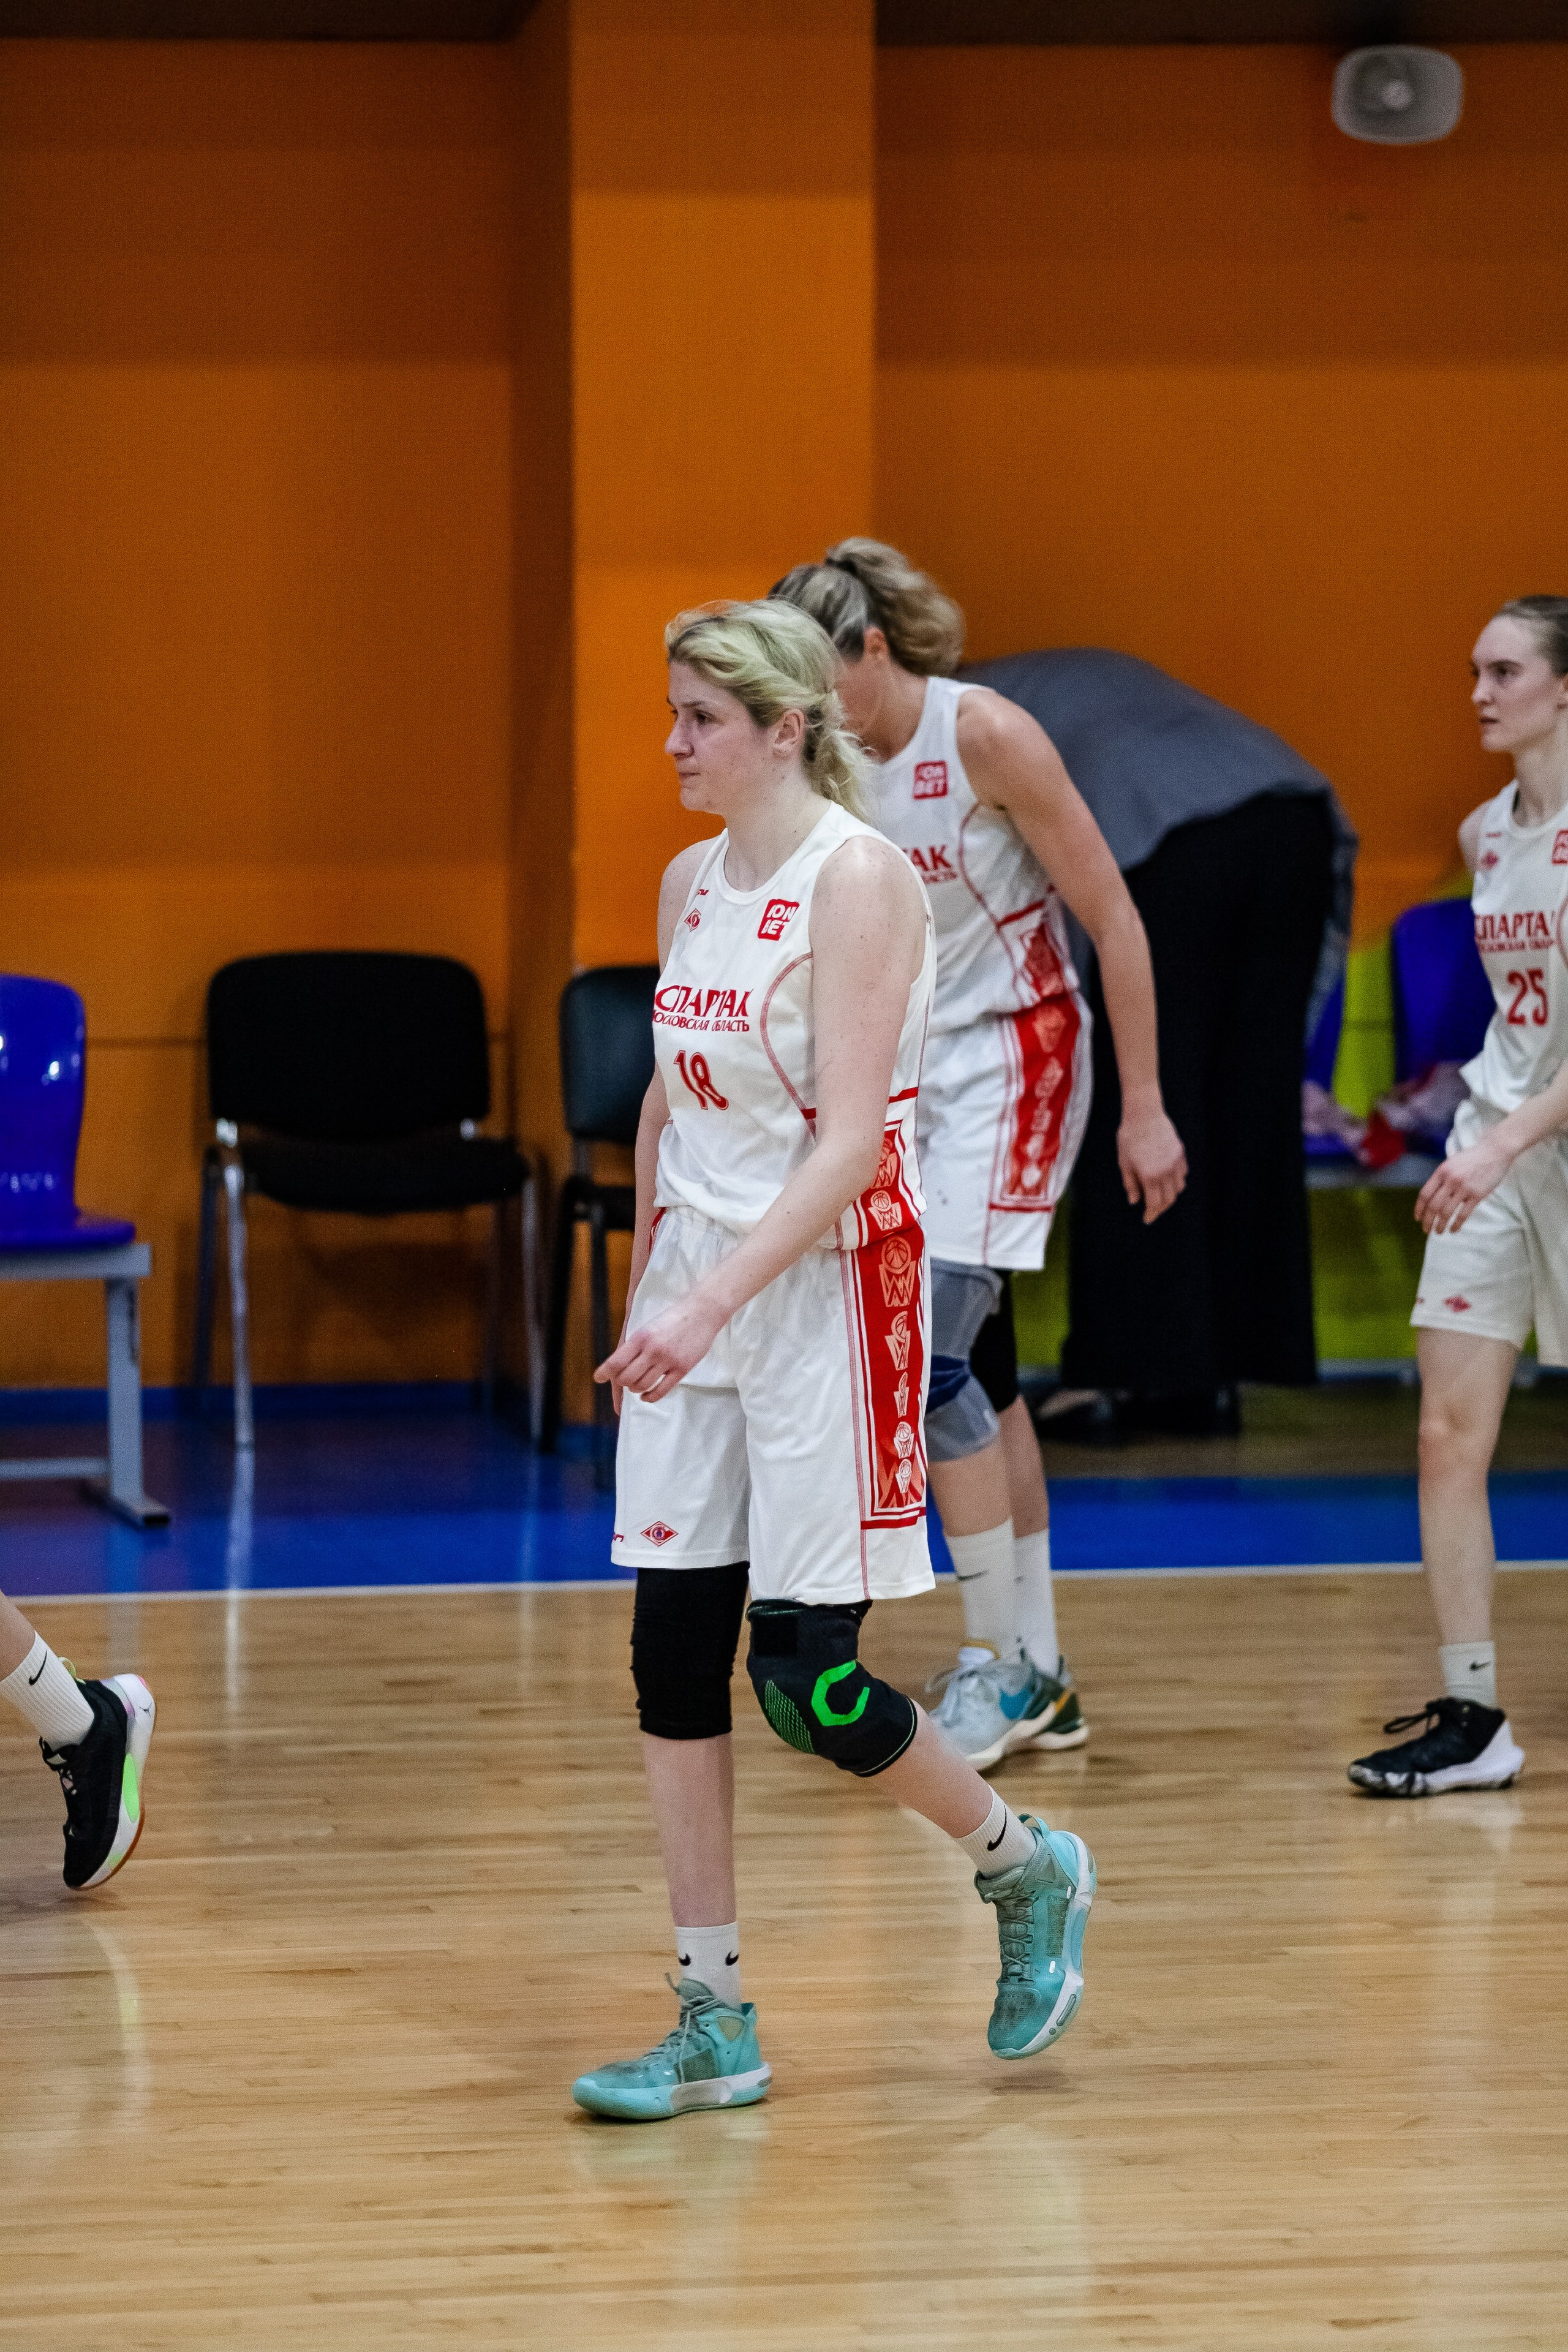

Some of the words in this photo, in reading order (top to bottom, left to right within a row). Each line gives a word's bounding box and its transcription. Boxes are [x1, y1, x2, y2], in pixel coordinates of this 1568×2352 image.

[902, 844, 952, 871] АК
[655, 985, 753, 1017] СПАРТАК
[1507, 968, 1548, 1026] 25
